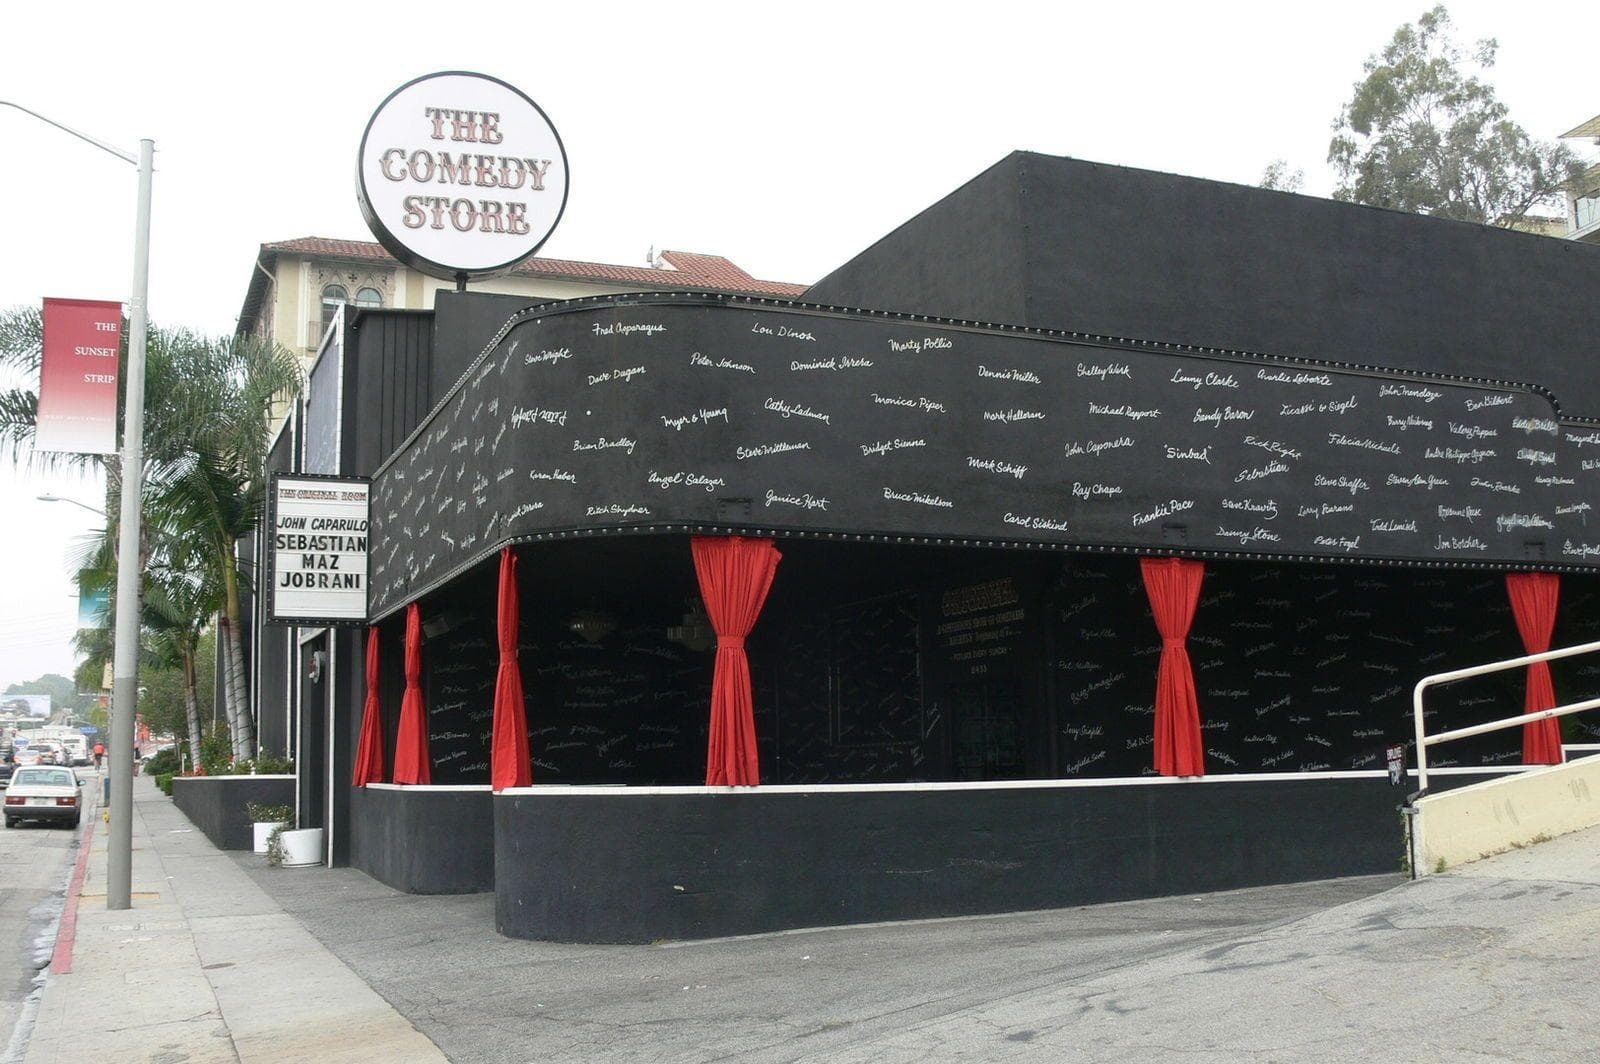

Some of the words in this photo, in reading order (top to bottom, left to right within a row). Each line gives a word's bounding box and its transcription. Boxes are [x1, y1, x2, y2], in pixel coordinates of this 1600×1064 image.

[425, 106, 504, 144] THE
[379, 148, 551, 191] COMEDY
[402, 195, 531, 235] STORE
[94, 322, 117, 332] THE
[593, 323, 614, 335] Fred
[752, 323, 773, 335] Lou
[74, 346, 116, 357] SUNSET
[888, 339, 921, 353] Marty
[525, 351, 543, 365] Steve
[541, 348, 573, 361] Wright
[690, 352, 714, 367] Peter
[716, 359, 755, 374] Johnson
[83, 373, 115, 384] STRIP
[588, 372, 611, 386] Dave
[978, 366, 1010, 380] Dennis
[1011, 369, 1041, 385] Miller
[1378, 385, 1401, 399] John
[765, 398, 791, 419] Cathy
[871, 394, 917, 407] Monica
[919, 398, 947, 413] Piper
[1088, 402, 1125, 417] Michael
[699, 407, 729, 424] Young
[983, 411, 1008, 424] Mark
[1193, 408, 1222, 428] Sandy
[573, 440, 598, 452] Brian
[598, 438, 637, 454] Bradley
[735, 447, 763, 460] Steve
[1065, 443, 1085, 458] John
[967, 457, 996, 473] Mark
[995, 462, 1028, 479] Schiff
[1314, 474, 1338, 487] Steve
[342, 491, 366, 501] ROOM
[883, 487, 913, 501] Bruce
[1072, 482, 1091, 500] Ray
[1092, 484, 1123, 497] Chapa
[765, 489, 803, 506] Janice
[801, 493, 831, 511] Hart
[1004, 512, 1031, 529] Carol
[1132, 505, 1171, 527] Frankie
[1169, 500, 1195, 516] Pace
[277, 517, 306, 529] JOHN
[311, 518, 368, 532] CAPARULO
[277, 535, 366, 552] SEBASTIAN
[303, 554, 339, 569] MAZ
[281, 573, 360, 588] JOBRANI
